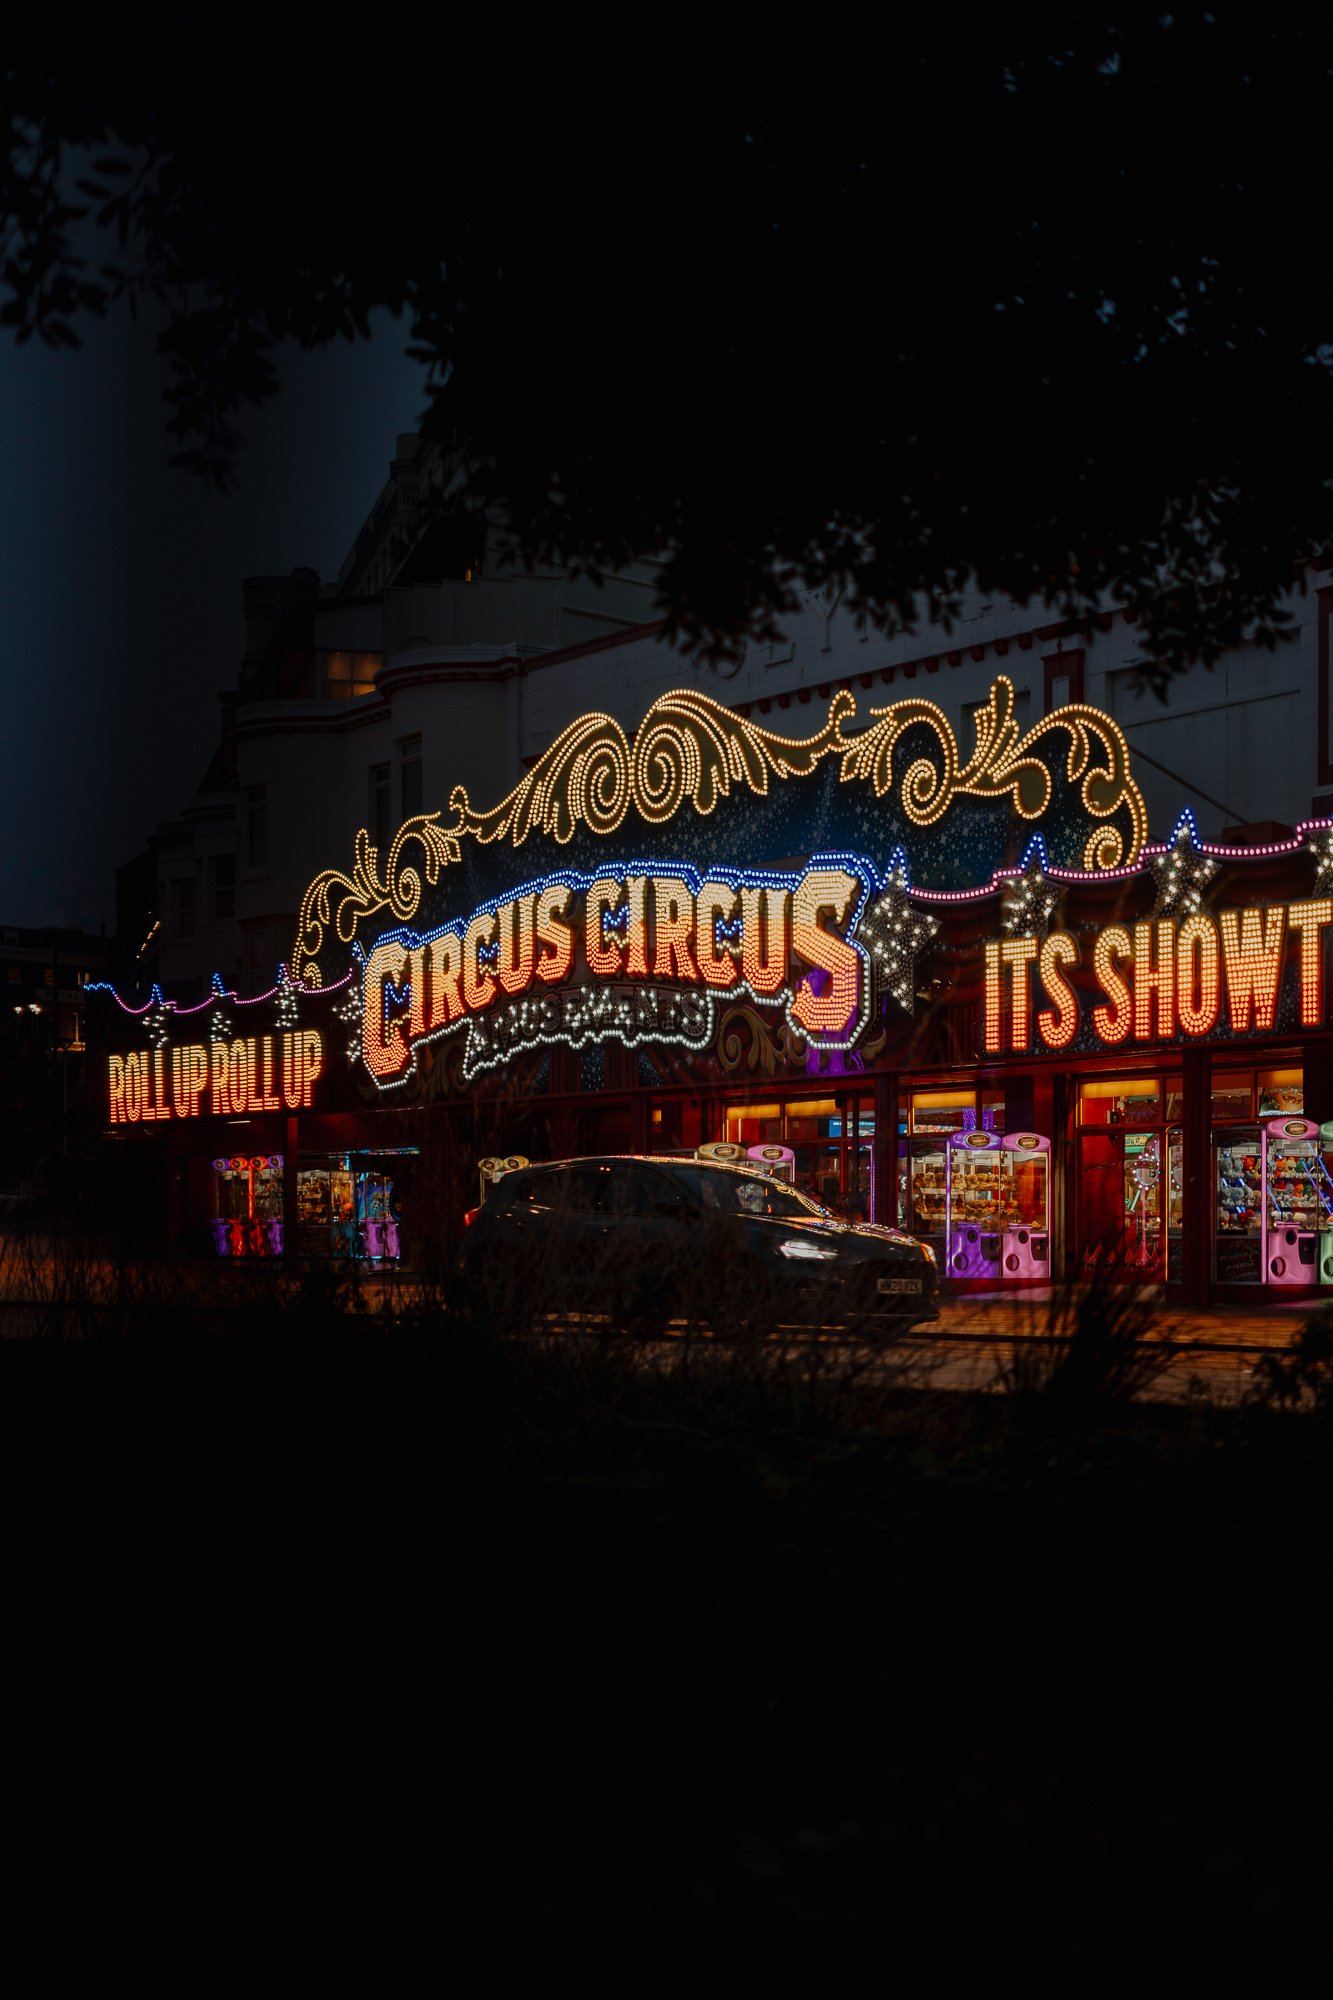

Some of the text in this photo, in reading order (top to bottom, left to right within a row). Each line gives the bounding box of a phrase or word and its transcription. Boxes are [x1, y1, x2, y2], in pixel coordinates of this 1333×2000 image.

[363, 869, 860, 1078] CIRCUS CIRCUS
[469, 985, 707, 1060] AMUSEMENTS
[984, 931, 1080, 1053] ITS
[108, 1029, 322, 1123] ROLL UP ROLL UP
